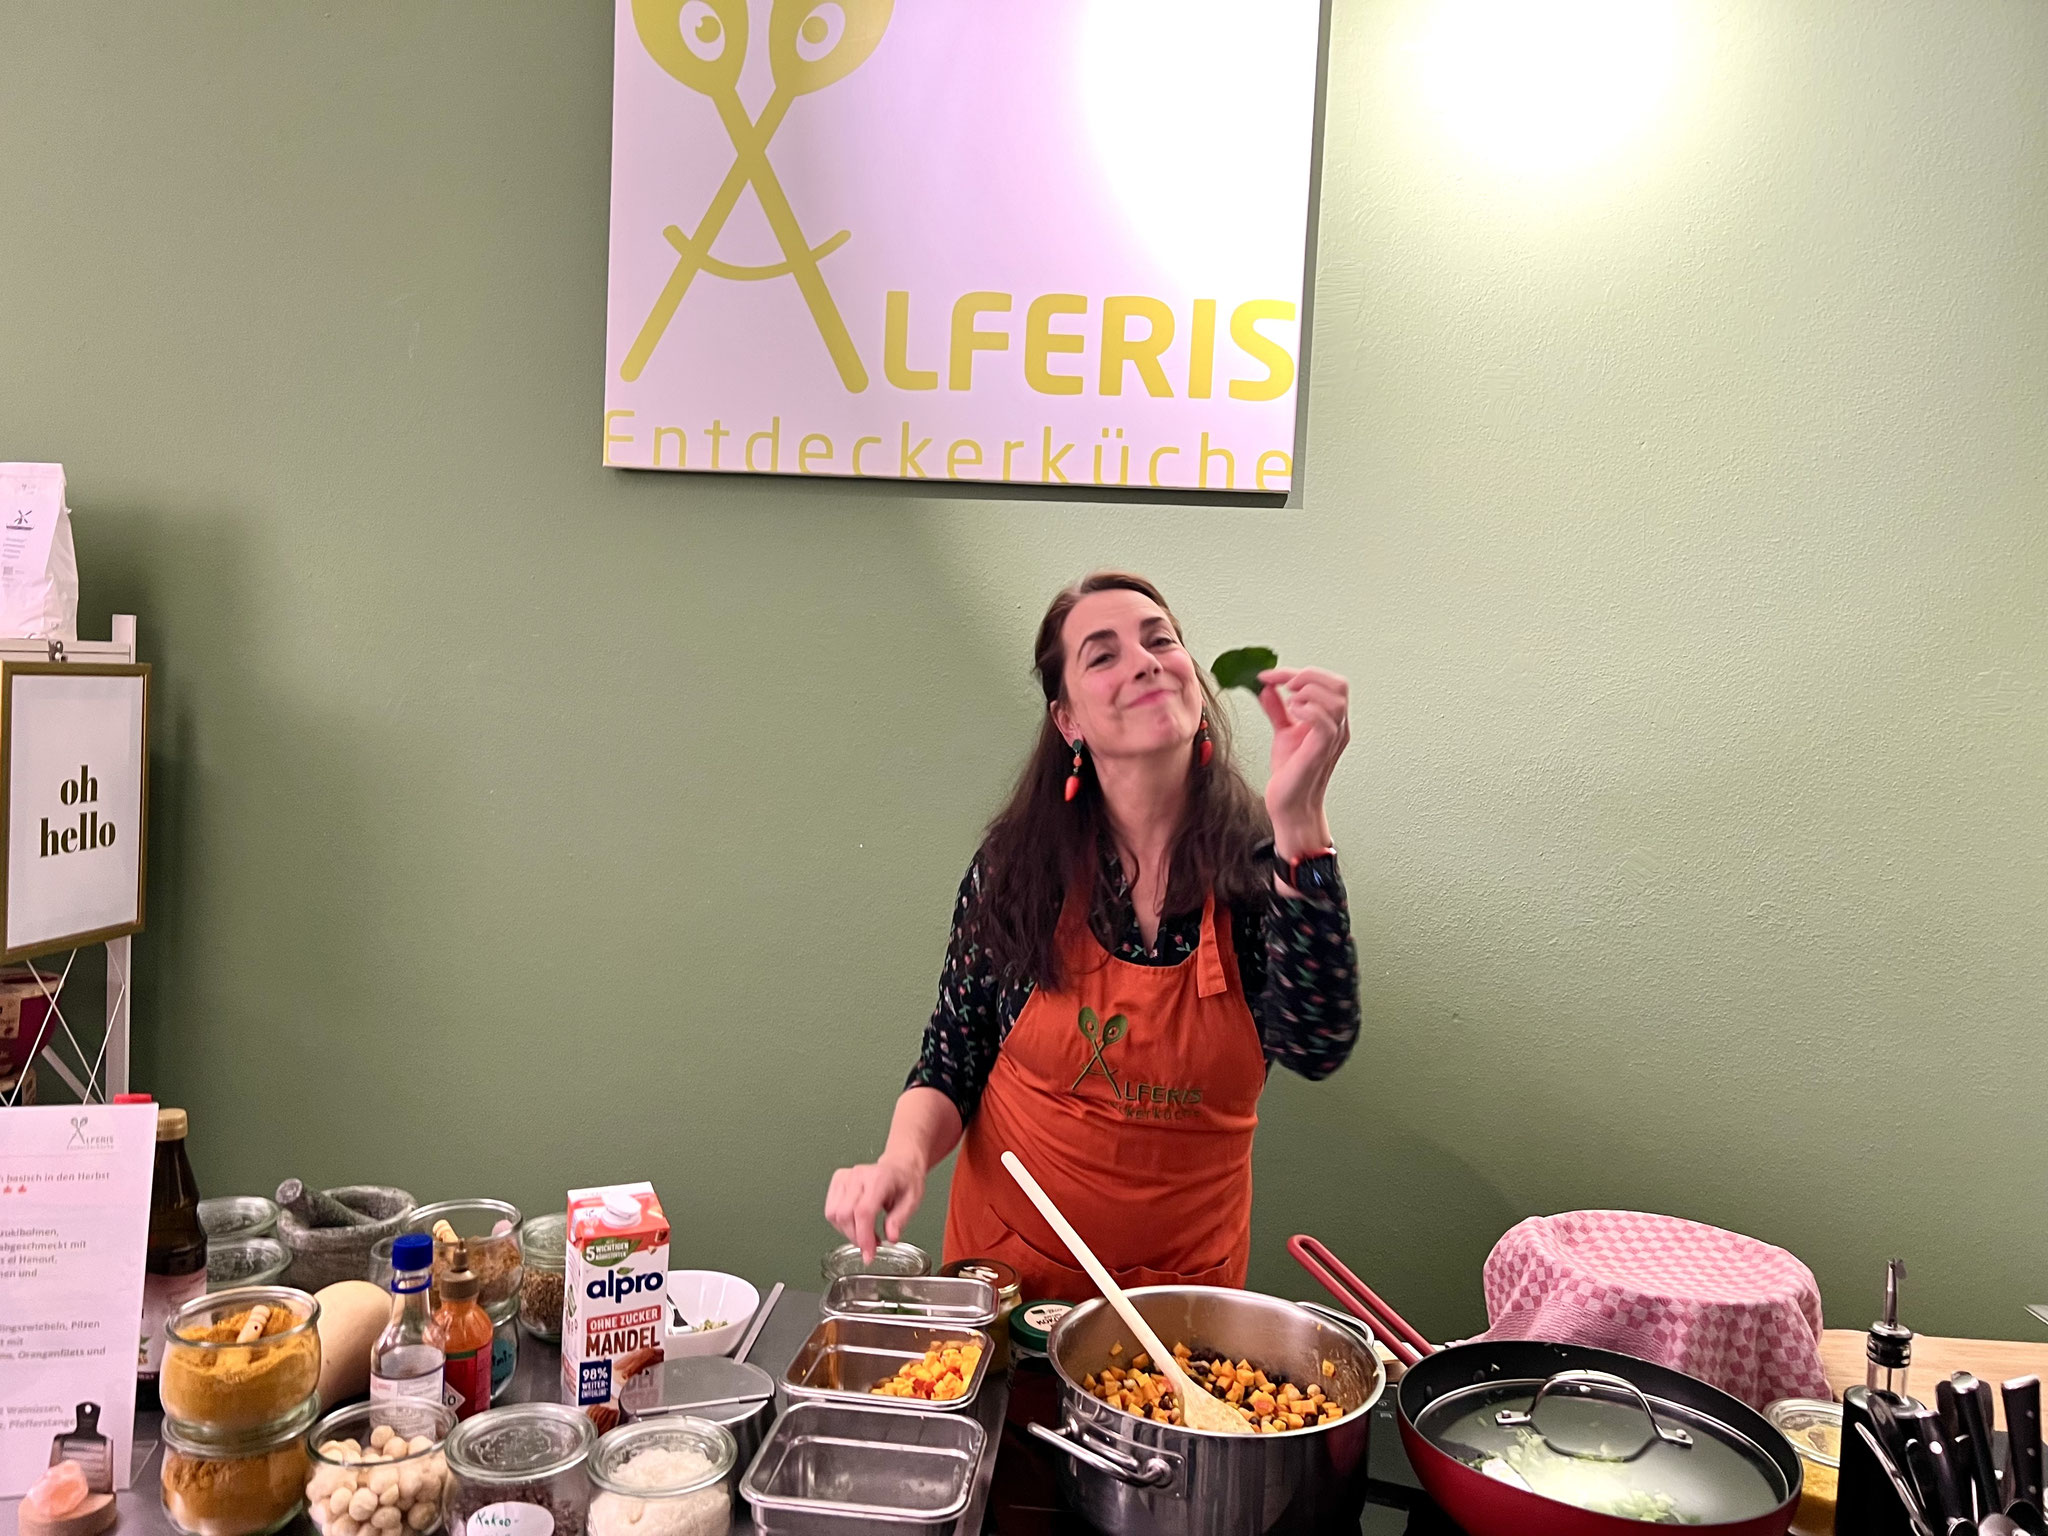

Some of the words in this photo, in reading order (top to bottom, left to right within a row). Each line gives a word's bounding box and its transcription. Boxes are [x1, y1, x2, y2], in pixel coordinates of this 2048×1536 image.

[605, 410, 1292, 490] Entdeckerküche
[60, 764, 98, 806] oh
[39, 811, 116, 858] hello
[585, 1245, 596, 1261] 5
[586, 1268, 664, 1304] alpro
[590, 1315, 618, 1332] OHNE
[620, 1308, 658, 1324] ZUCKER
[585, 1325, 660, 1358] MANDEL
[582, 1366, 609, 1381] 98%
